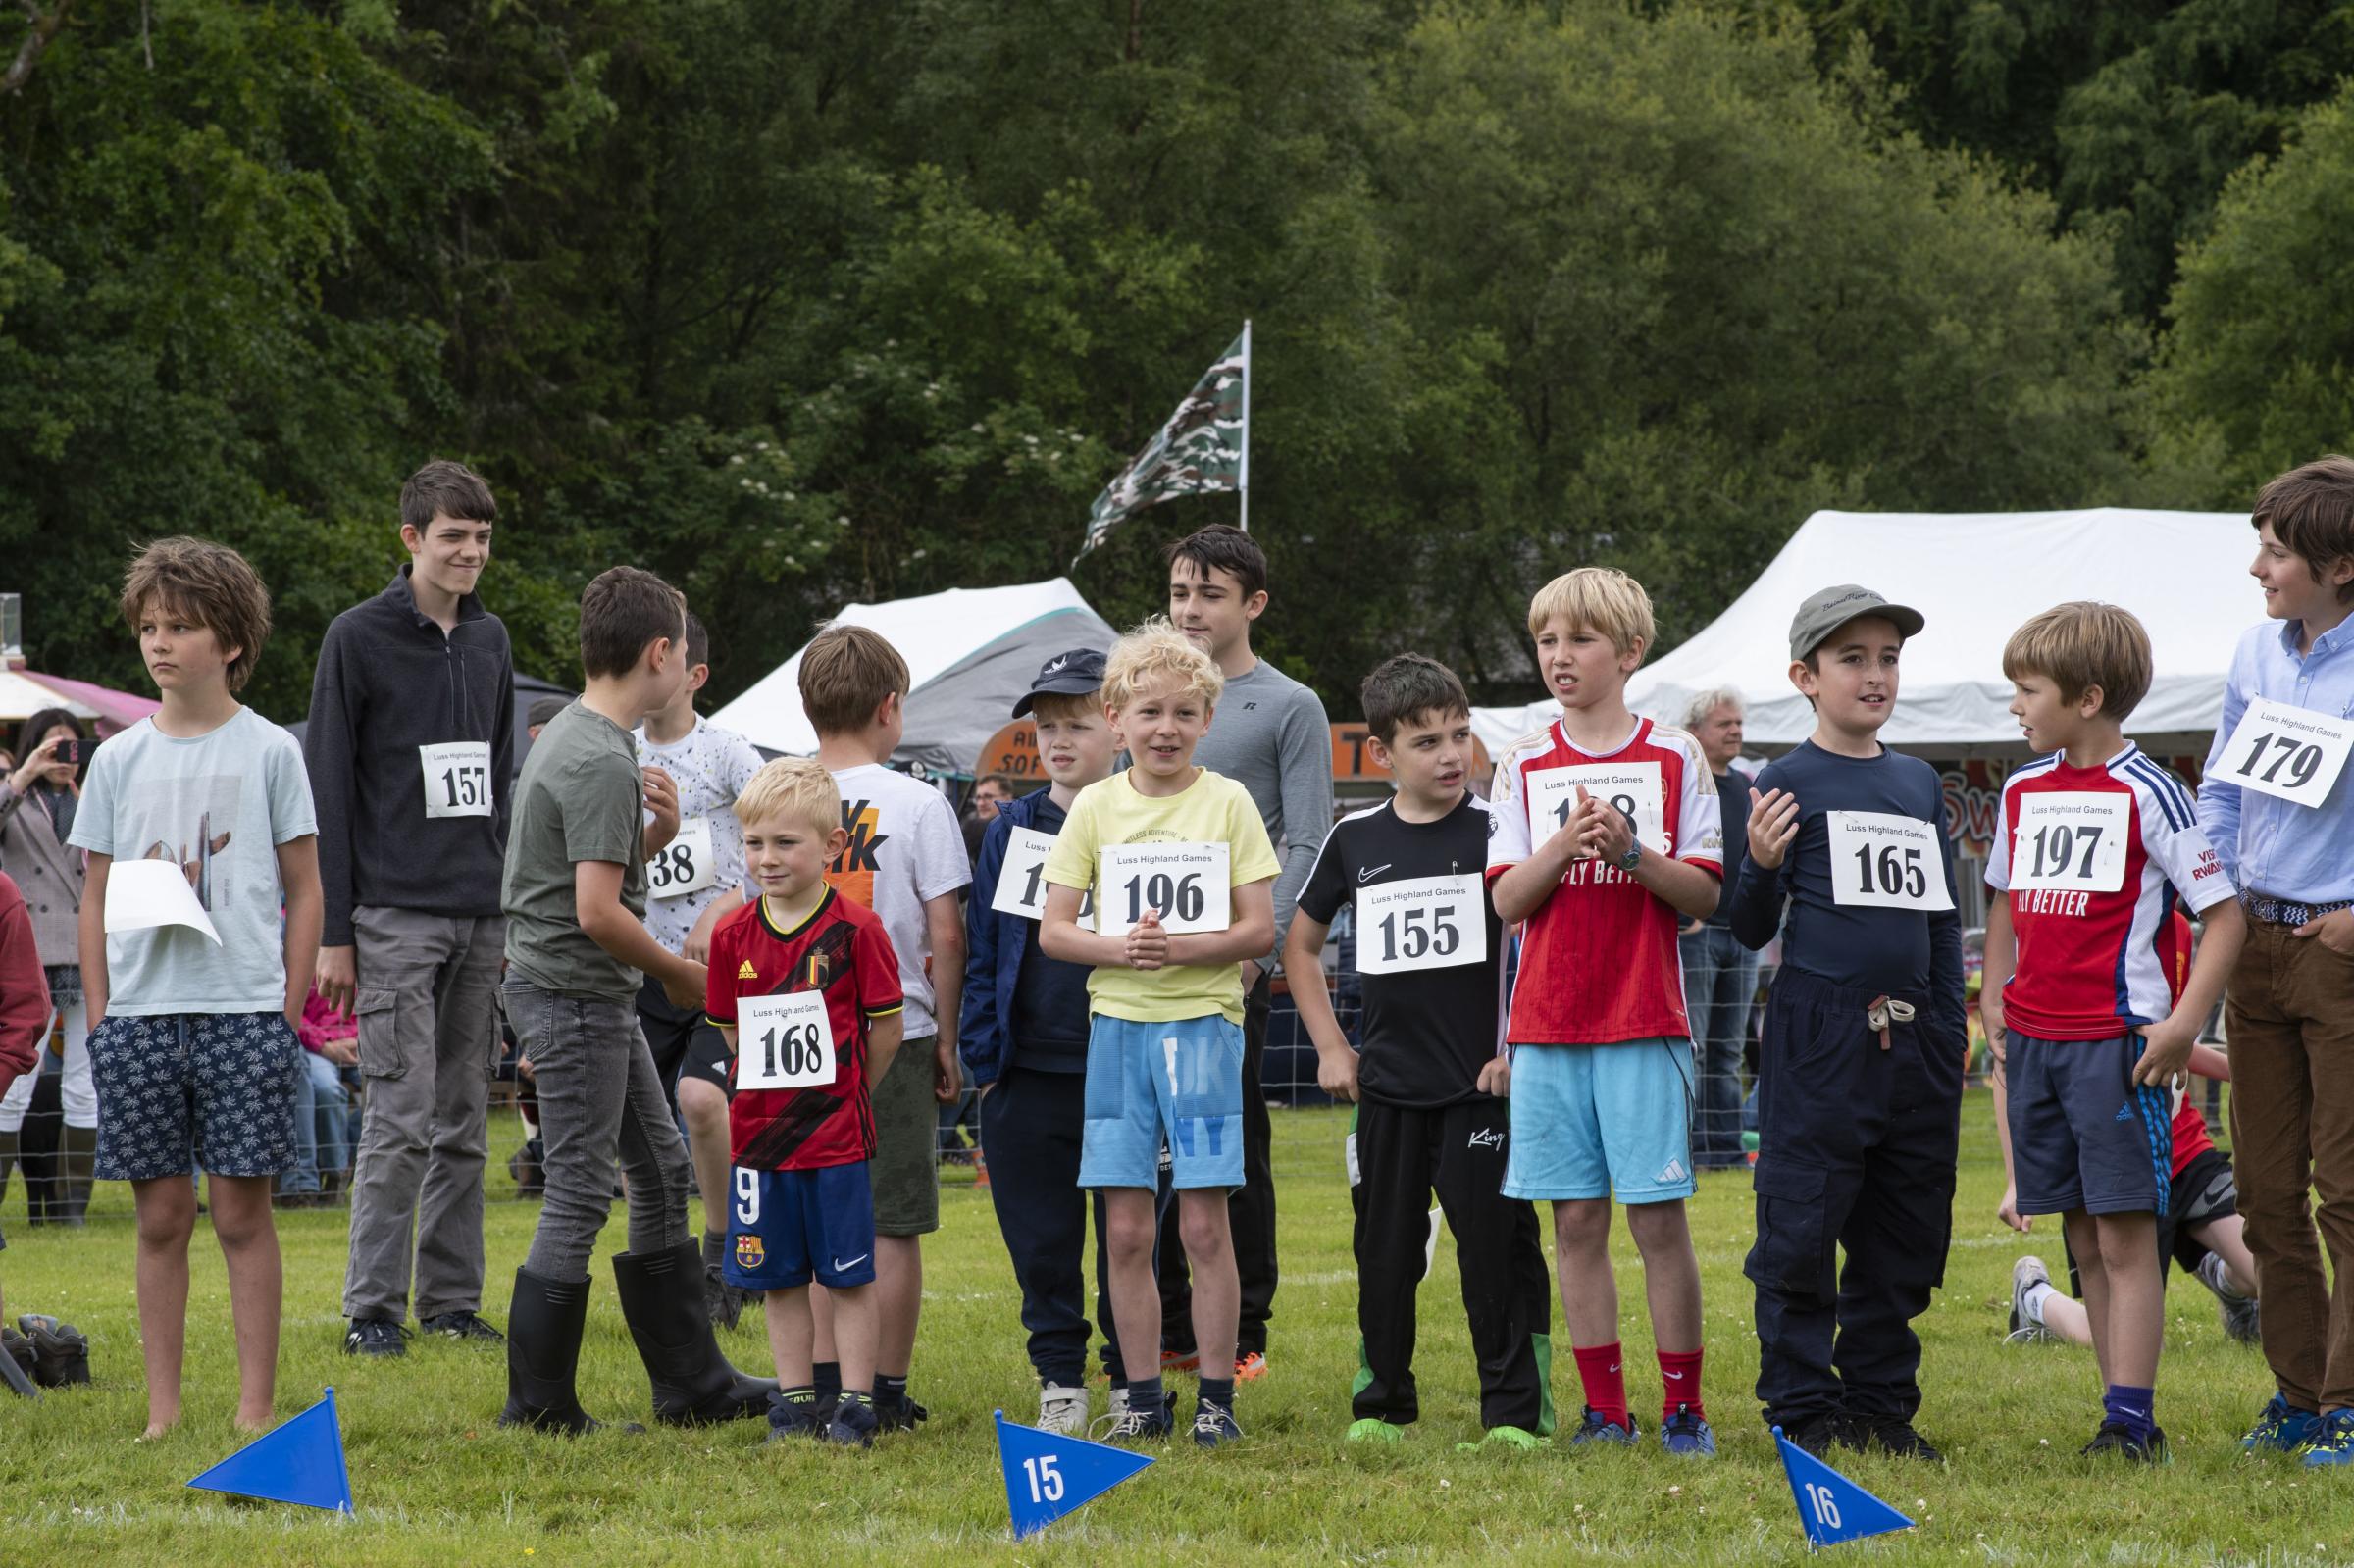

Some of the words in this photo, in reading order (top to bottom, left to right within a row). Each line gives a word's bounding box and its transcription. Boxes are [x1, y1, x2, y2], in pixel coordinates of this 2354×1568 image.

[2260, 712, 2279, 724] Luss
[2280, 717, 2316, 733] Highland
[2315, 727, 2342, 739] Games
[1000, 752, 1041, 775] SOF
[2236, 733, 2323, 788] 179
[441, 767, 486, 808] 157
[1568, 776, 1610, 786] Highland
[1553, 794, 1638, 838] 18
[2031, 805, 2048, 815] Luss
[2049, 805, 2081, 816] Highland
[2082, 805, 2113, 815] Games
[678, 829, 696, 837] ames
[1846, 823, 1867, 833] Luss
[1868, 825, 1903, 836] Highland
[1904, 830, 1928, 840] Games
[1025, 840, 1046, 852] Luss
[1140, 854, 1179, 865] Highland
[2030, 824, 2104, 879] 197
[644, 844, 695, 888] 38
[1854, 842, 1926, 899] 165
[2192, 860, 2225, 881] RWAN
[1124, 872, 1204, 924] 196
[1371, 895, 1392, 905] Luss
[1393, 889, 1433, 901] Highland
[1435, 887, 1466, 896] Games
[2031, 889, 2090, 917] BETTER
[1378, 905, 1460, 962] 155
[753, 1009, 773, 1018] Luss
[774, 1006, 805, 1018] Highland
[804, 1004, 820, 1013] Games
[760, 1023, 823, 1078] 168
[1467, 1127, 1506, 1152] King
[736, 1166, 760, 1225] 9
[1023, 1454, 1064, 1503] 15
[1804, 1482, 1842, 1530] 16
